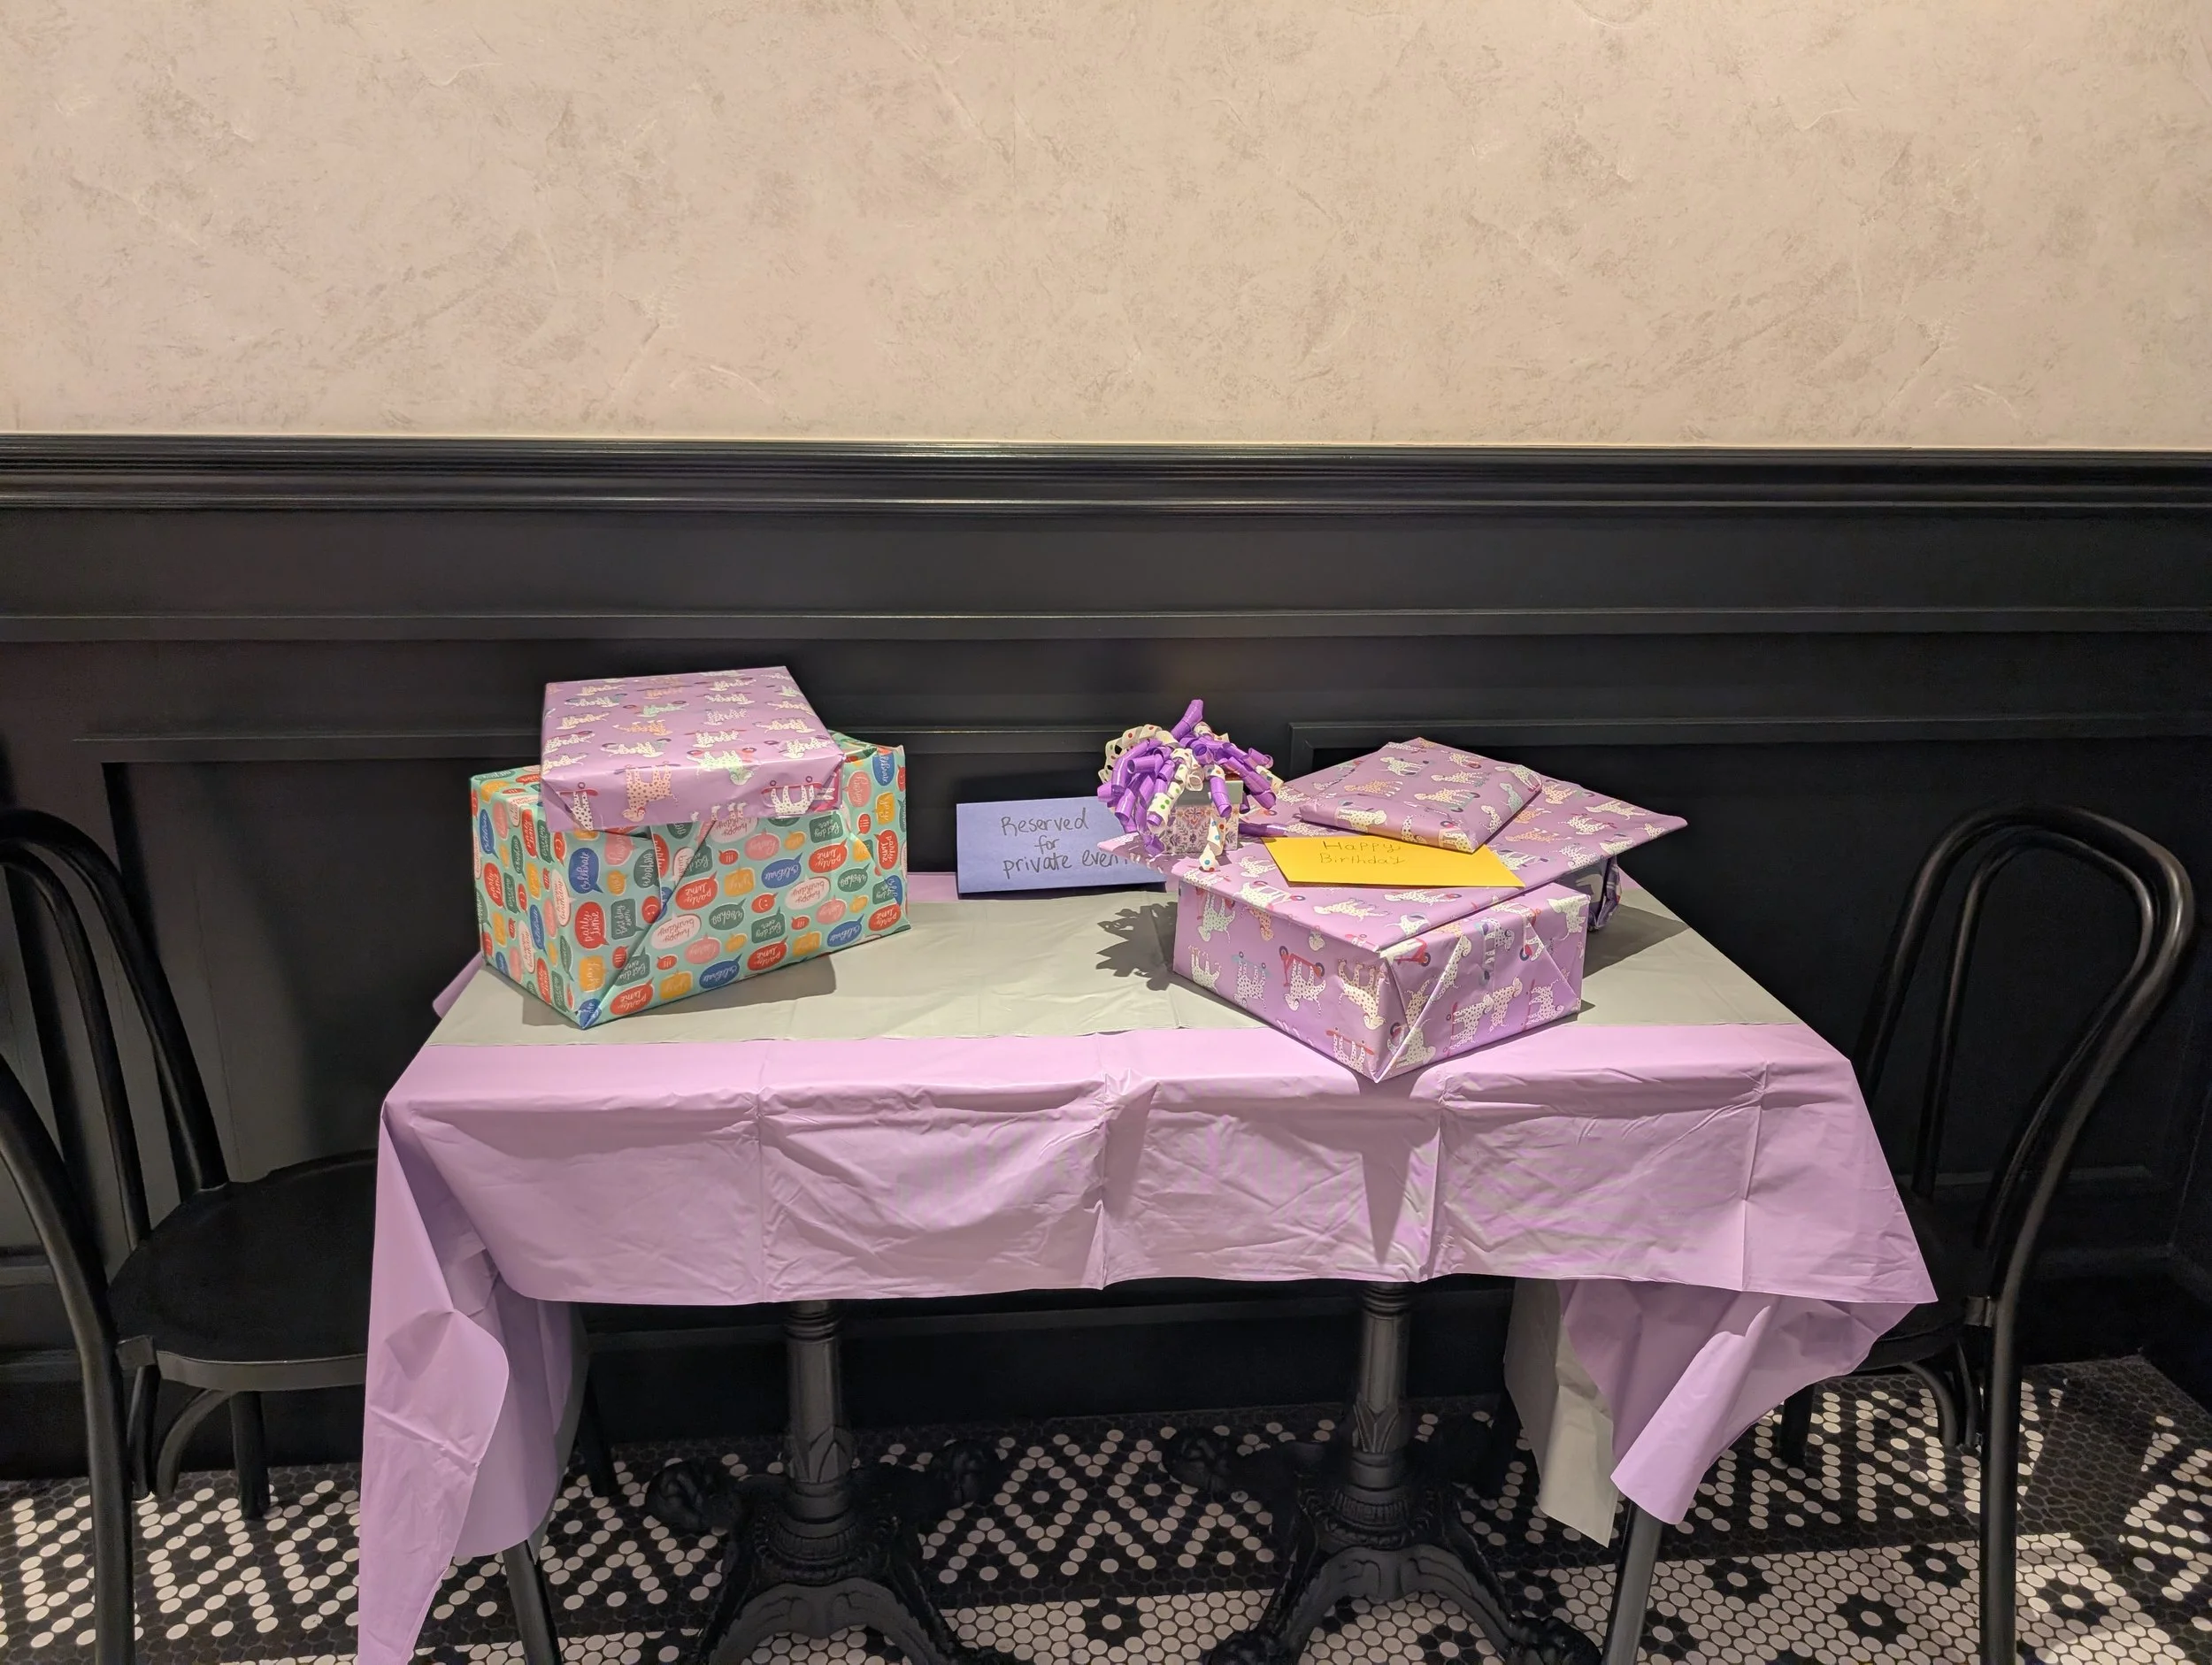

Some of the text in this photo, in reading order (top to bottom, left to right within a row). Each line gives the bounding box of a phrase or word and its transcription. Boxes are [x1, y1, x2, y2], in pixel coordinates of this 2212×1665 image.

[1001, 807, 1089, 837] Reserved
[721, 823, 749, 837] happy
[1034, 834, 1060, 855] for
[1322, 840, 1402, 853] Happy
[817, 848, 838, 859] time
[1319, 852, 1406, 865] Birthday
[640, 852, 654, 886] woohoo
[816, 854, 841, 870] party
[1002, 852, 1072, 880] private
[685, 881, 708, 893] time
[839, 872, 867, 887] woohoo
[791, 880, 826, 897] birthday
[685, 888, 711, 905] party
[795, 889, 821, 904] happy
[711, 909, 743, 925] woohoo
[874, 912, 897, 926] party
[876, 907, 894, 918] time
[580, 910, 595, 942] party
[591, 910, 603, 937] time
[657, 917, 695, 936] birthday
[664, 927, 690, 942] happy
[755, 951, 781, 966] party
[757, 946, 777, 959] time
[620, 987, 642, 1001] time
[618, 994, 647, 1010] party
